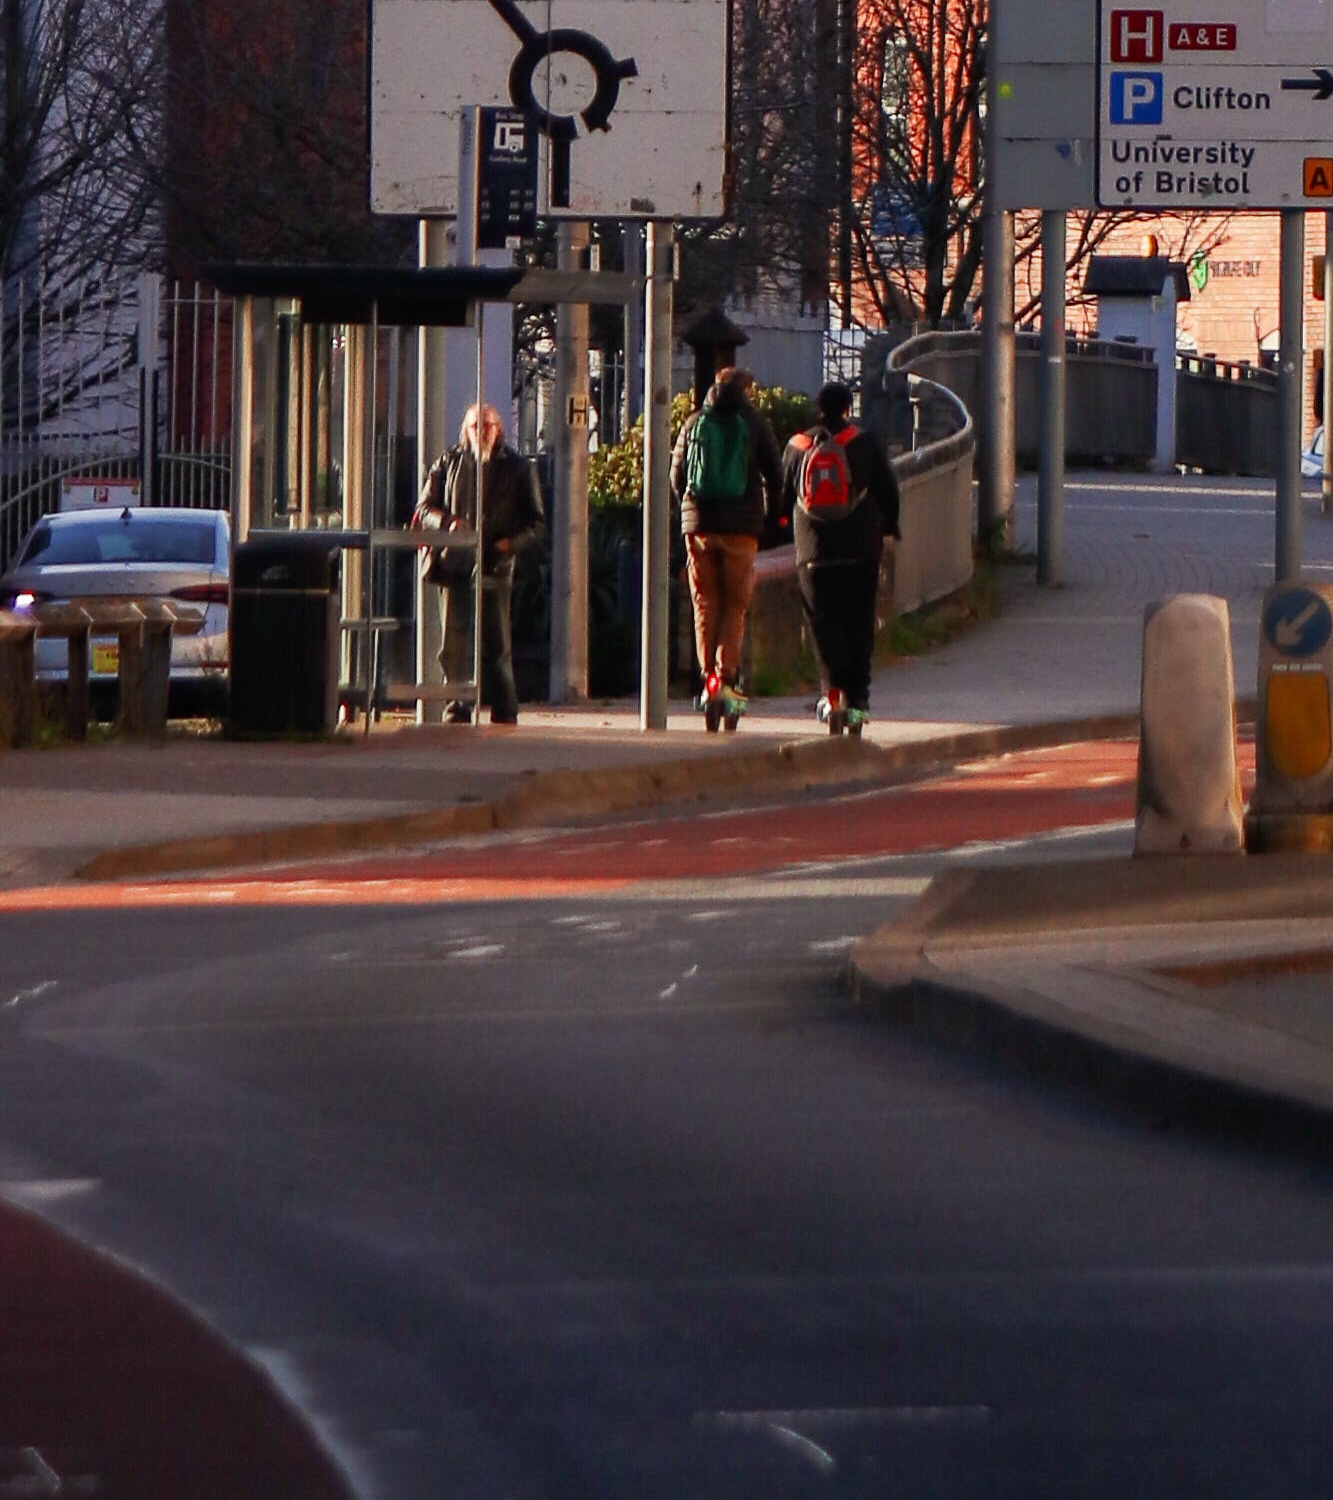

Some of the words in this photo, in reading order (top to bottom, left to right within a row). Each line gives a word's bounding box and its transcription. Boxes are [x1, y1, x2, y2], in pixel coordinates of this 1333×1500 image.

[1120, 15, 1155, 58] H
[1122, 77, 1155, 120] P
[1172, 86, 1271, 110] Clifton
[1111, 141, 1256, 167] University
[1115, 171, 1144, 194] of
[1155, 171, 1250, 195] Bristol
[1308, 167, 1330, 190] A
